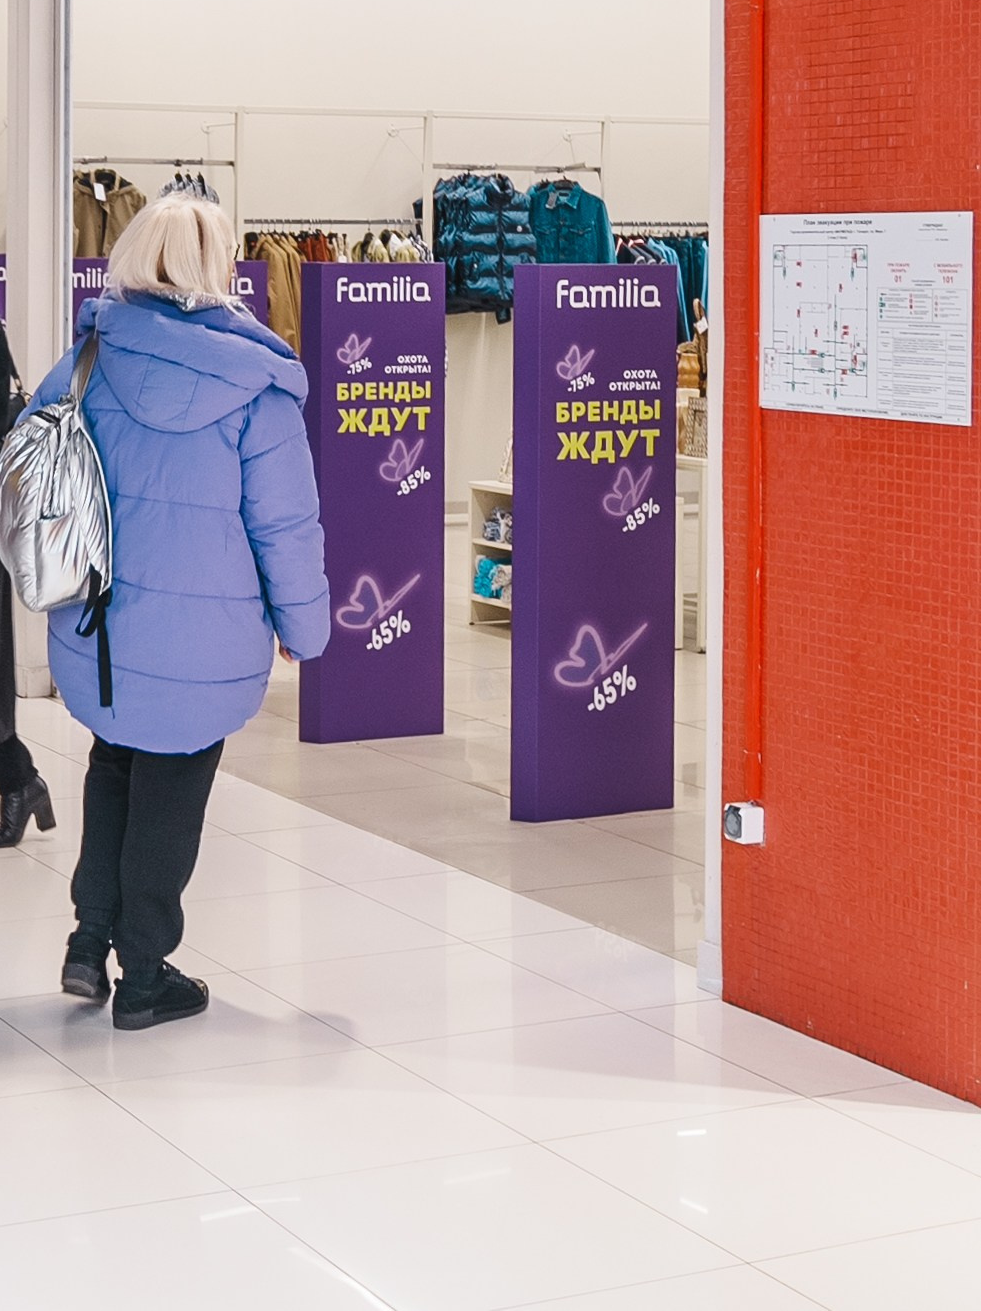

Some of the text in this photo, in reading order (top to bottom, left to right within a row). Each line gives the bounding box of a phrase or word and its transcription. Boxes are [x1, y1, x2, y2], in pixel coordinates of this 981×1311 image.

[336, 276, 432, 303] familia
[556, 278, 661, 308] familia
[384, 365, 432, 375] ОТКРЫТА!
[396, 355, 429, 364] ОХОТА
[608, 381, 661, 391] ОТКРЫТА!
[622, 369, 658, 379] ОХОТА
[336, 381, 432, 403] БРЕНДЫ
[337, 407, 431, 436] ЖДУТ
[555, 399, 661, 424] БРЕНДЫ
[557, 429, 660, 464] ЖДУТ
[397, 466, 432, 497] -85%
[621, 497, 661, 534] -85%
[365, 610, 411, 653] -65%
[587, 665, 638, 713] -65%
